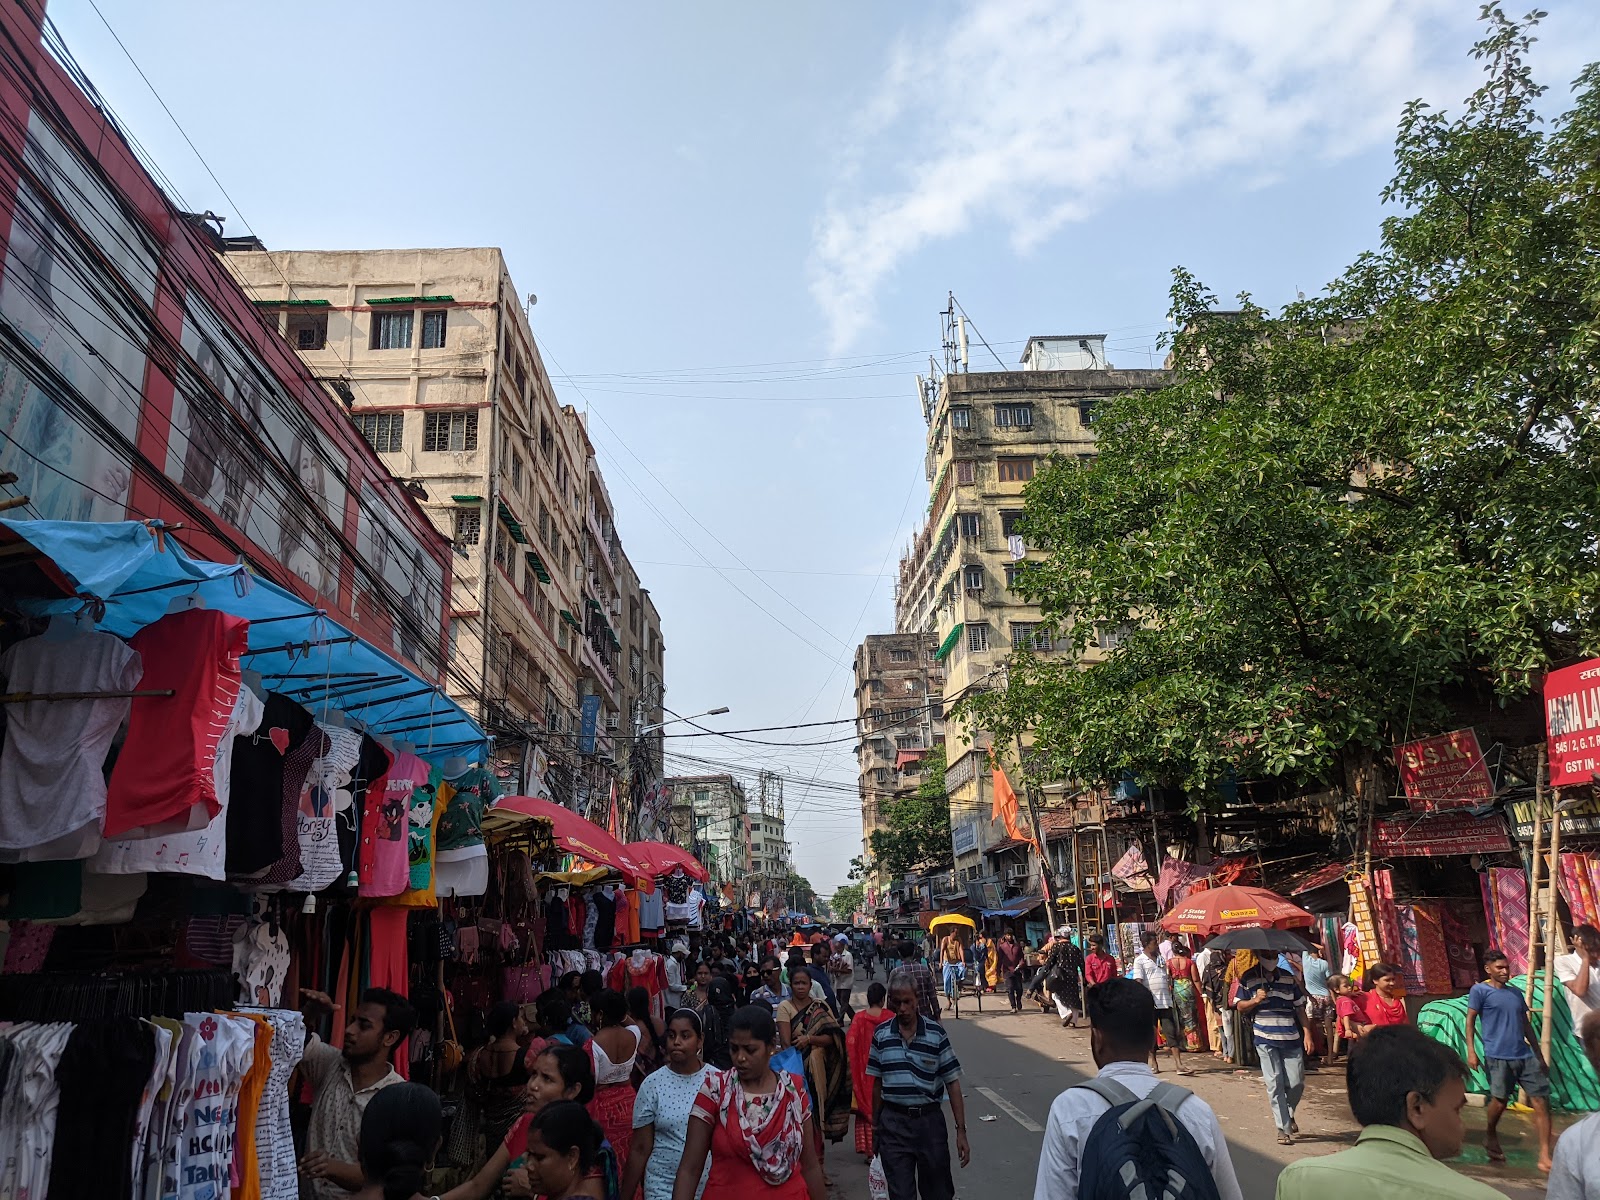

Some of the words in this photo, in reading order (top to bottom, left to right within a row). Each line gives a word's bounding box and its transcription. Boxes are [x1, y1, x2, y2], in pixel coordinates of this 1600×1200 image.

[1404, 742, 1471, 768] S.S.K.
[1565, 760, 1582, 773] GST
[1465, 827, 1497, 835] COVER
